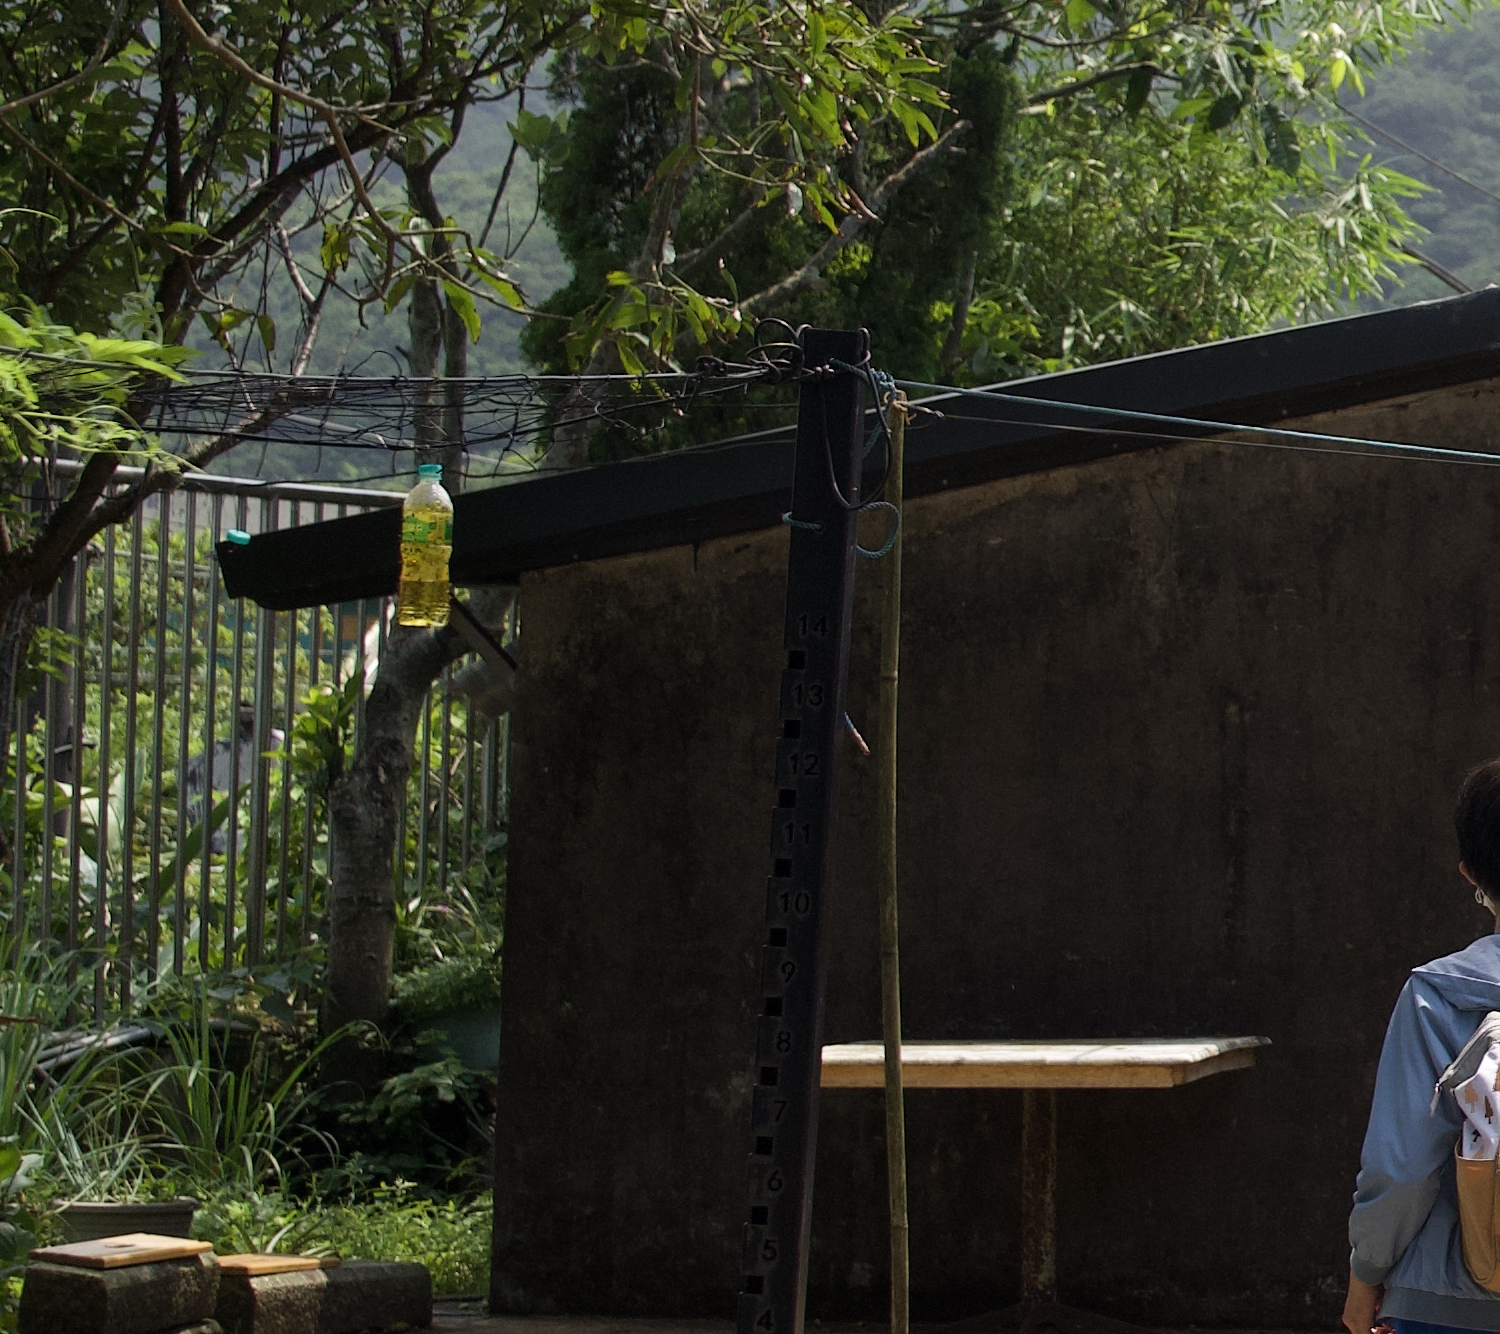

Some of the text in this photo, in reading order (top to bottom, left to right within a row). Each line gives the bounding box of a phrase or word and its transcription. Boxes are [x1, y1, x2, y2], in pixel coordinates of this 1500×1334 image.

[799, 614, 829, 637] 14
[792, 683, 824, 706] 13
[790, 753, 819, 776] 12
[785, 822, 811, 844] 11
[779, 892, 810, 914] 10
[781, 960, 796, 983] 9
[776, 1030, 791, 1053] 8
[773, 1100, 788, 1122] 7
[768, 1170, 782, 1192] 6
[762, 1239, 777, 1261] 5
[757, 1308, 773, 1331] 4
